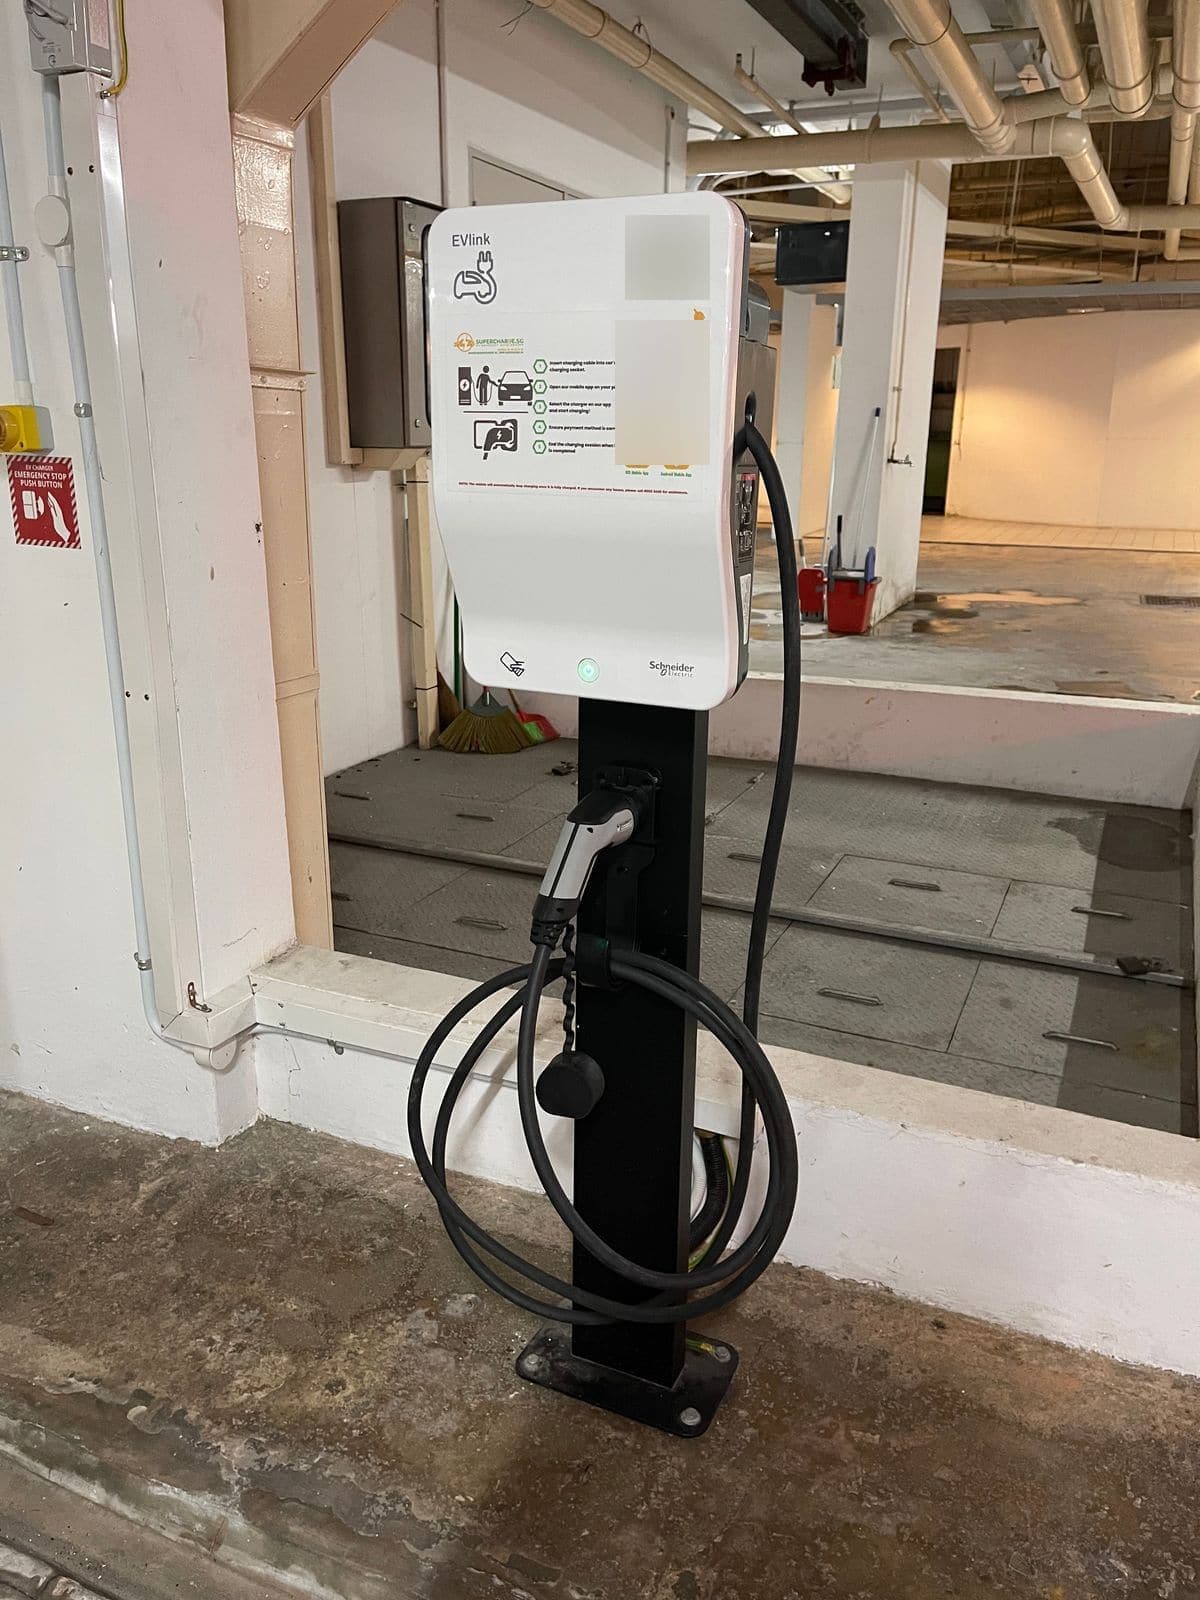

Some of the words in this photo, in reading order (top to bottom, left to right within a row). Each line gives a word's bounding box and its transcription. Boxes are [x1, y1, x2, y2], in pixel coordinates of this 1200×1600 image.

[452, 233, 490, 247] EVlink
[14, 471, 50, 480] EMERGENCY
[51, 472, 67, 480] STOP
[20, 480, 37, 488] PUSH
[38, 480, 63, 489] BUTTON
[649, 660, 694, 672] Schneider
